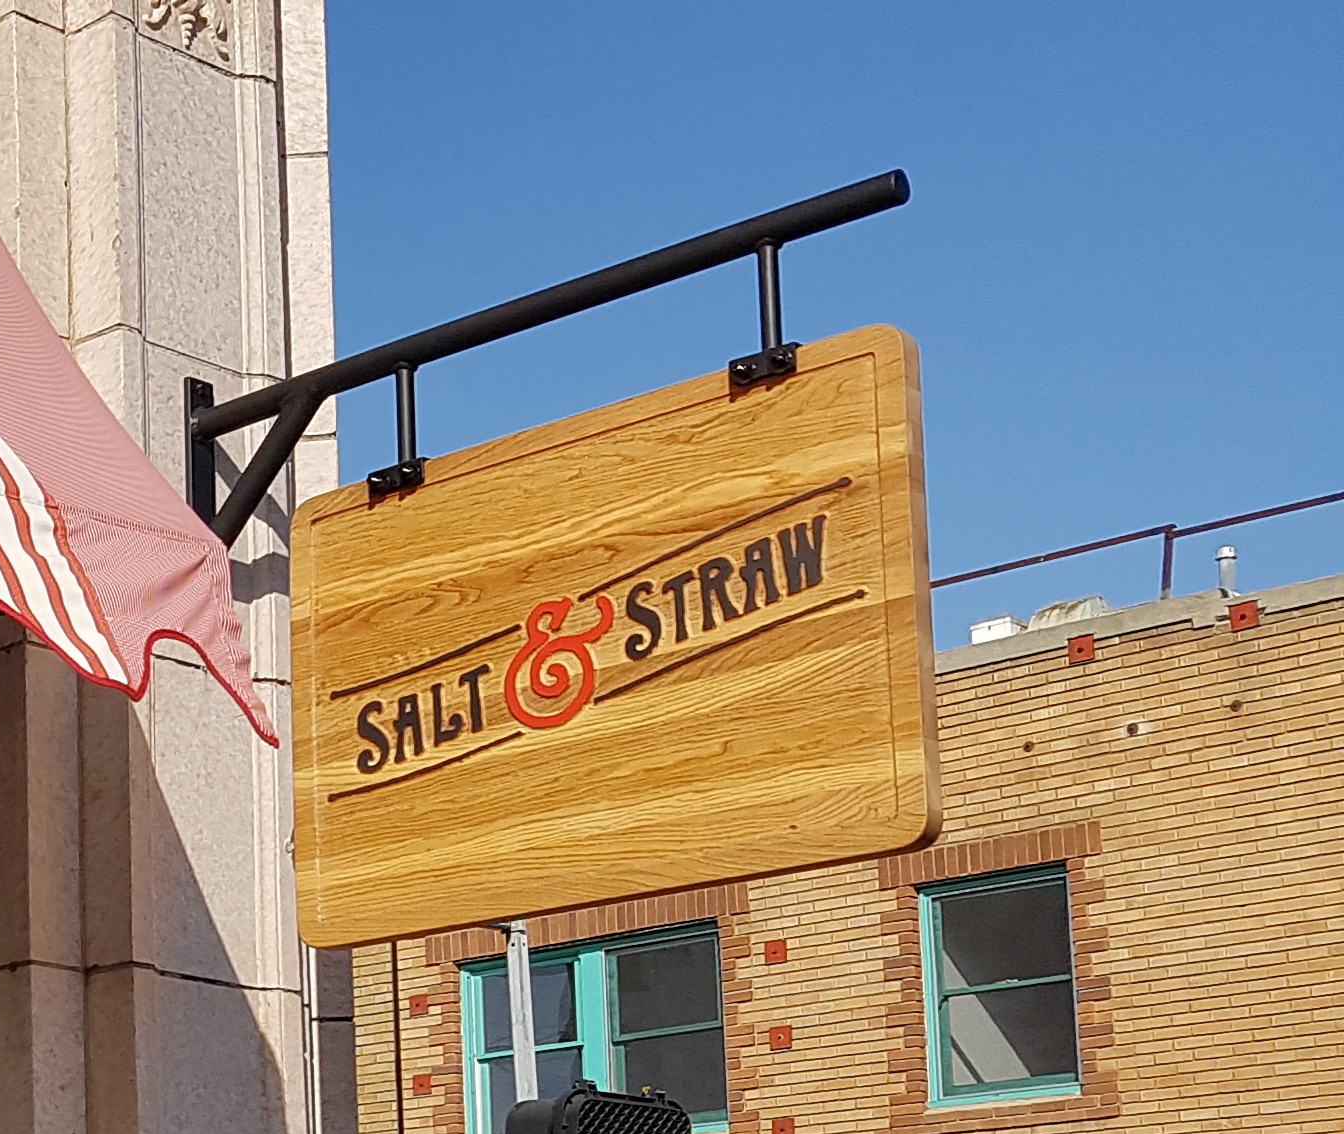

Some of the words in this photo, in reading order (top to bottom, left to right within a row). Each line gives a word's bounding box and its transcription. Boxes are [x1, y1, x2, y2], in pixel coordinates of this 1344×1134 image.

[356, 663, 492, 775] SALT
[504, 595, 615, 730] &
[624, 514, 827, 661] STRAW
